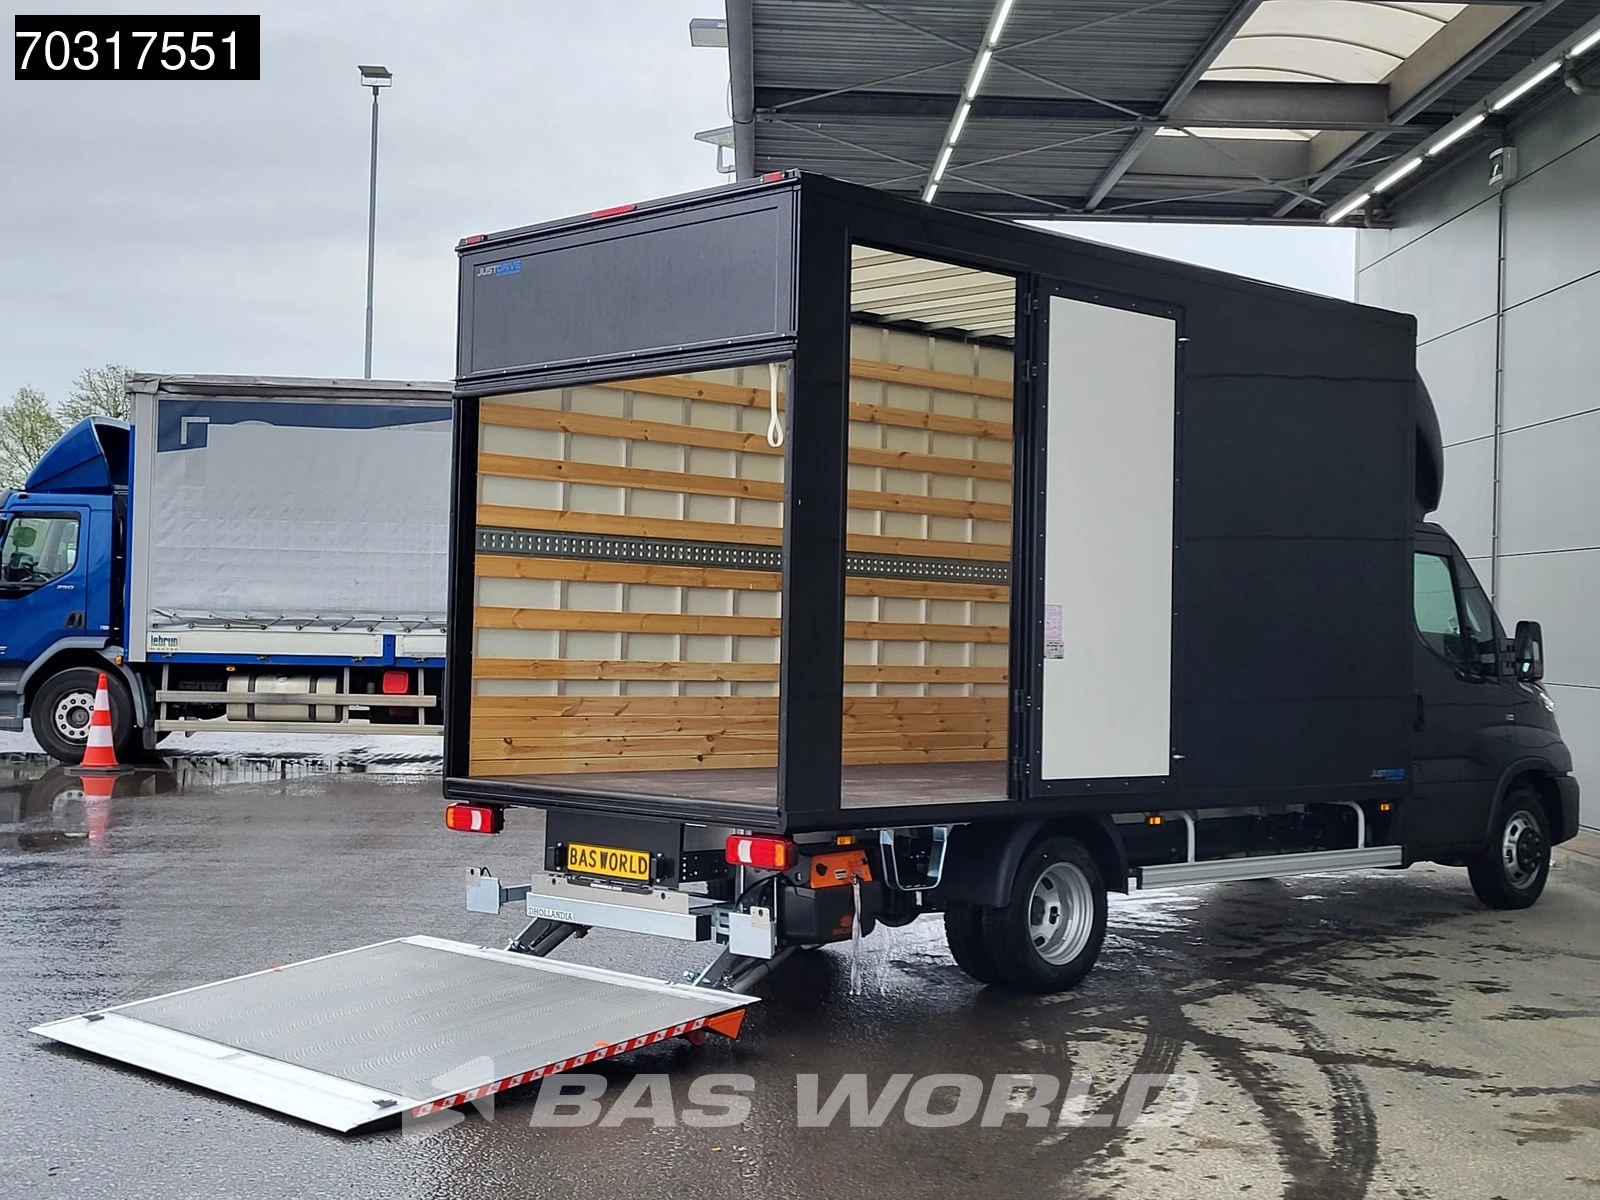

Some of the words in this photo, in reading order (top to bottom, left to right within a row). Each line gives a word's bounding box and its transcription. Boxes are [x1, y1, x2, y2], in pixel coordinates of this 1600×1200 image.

[151, 635, 178, 646] lebrun
[570, 847, 597, 868] BAS
[600, 851, 648, 875] WORLD
[528, 907, 573, 920] DHOLLANDIA
